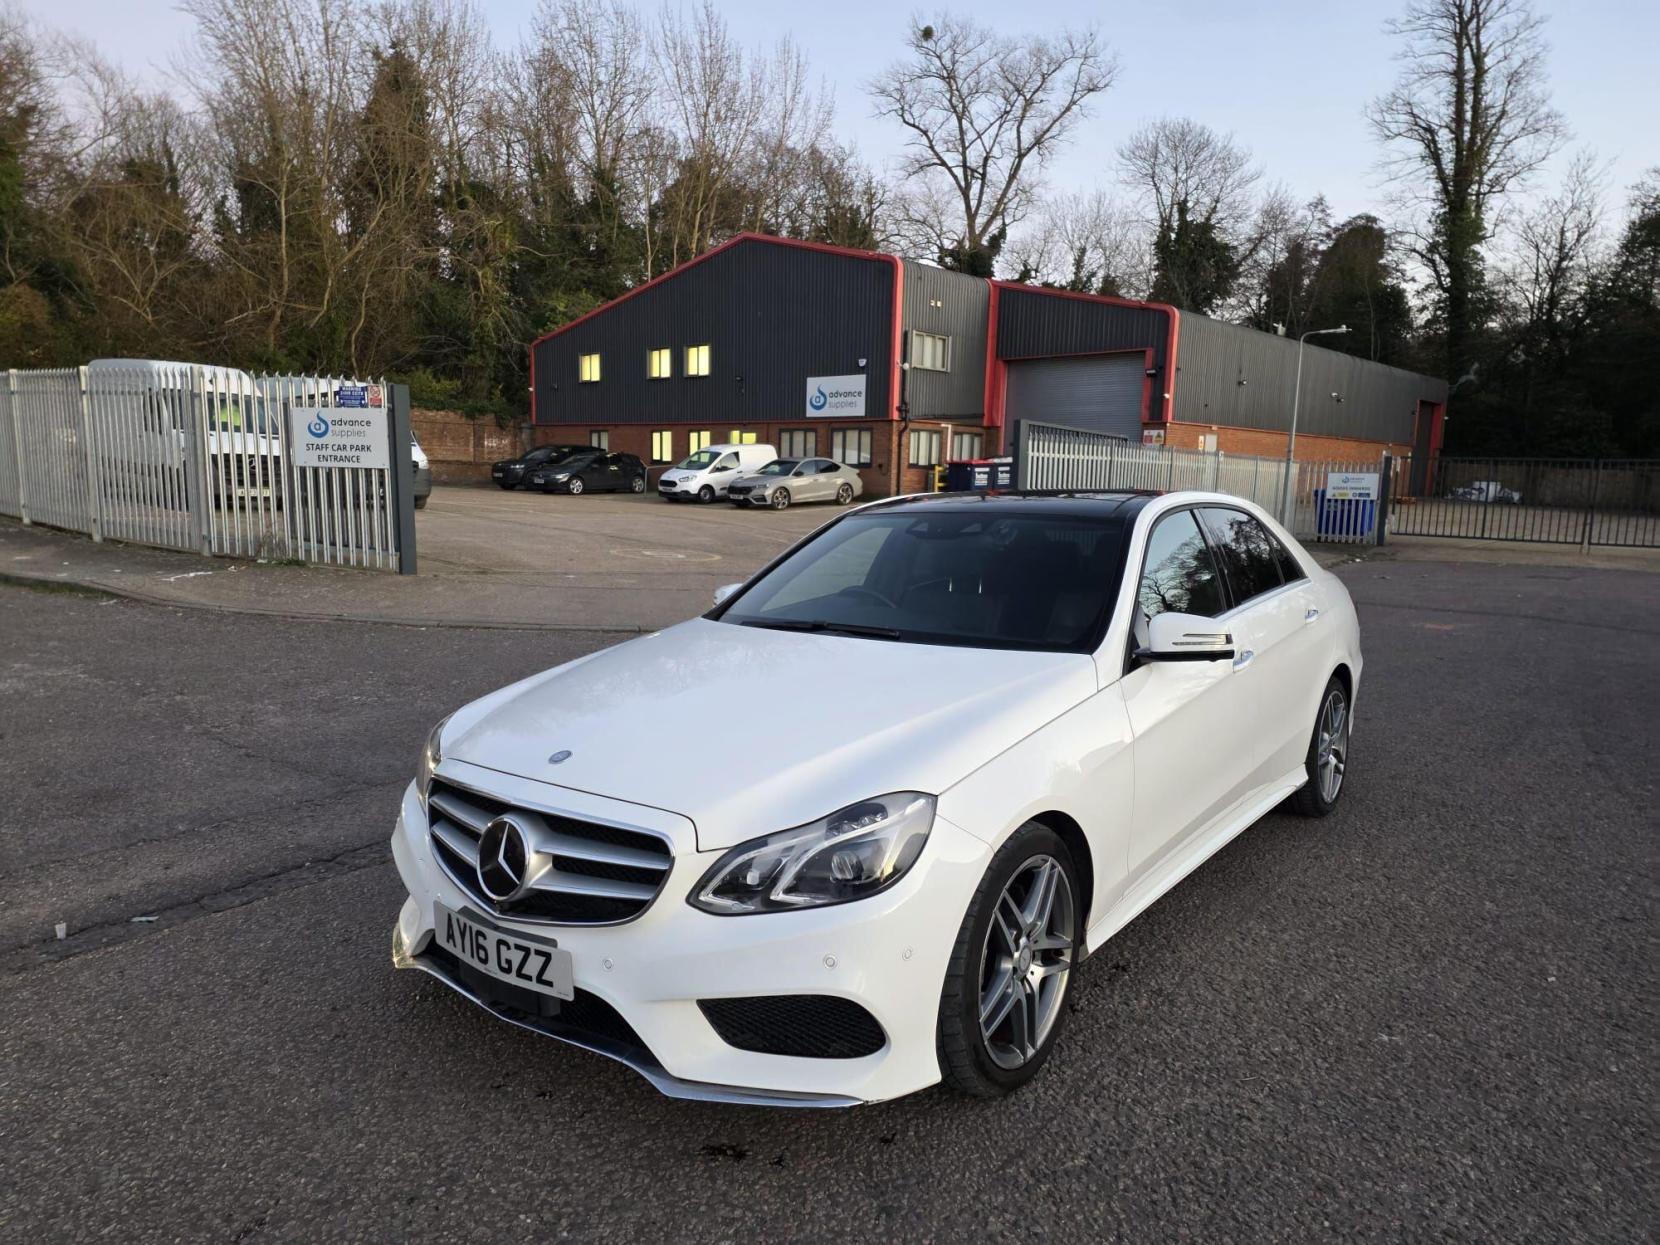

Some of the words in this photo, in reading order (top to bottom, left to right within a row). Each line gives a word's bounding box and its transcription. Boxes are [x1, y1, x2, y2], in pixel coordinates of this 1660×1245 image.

[828, 390, 863, 398] advance
[828, 400, 856, 409] supplies
[330, 418, 371, 427] advance
[331, 429, 366, 438] supplies
[305, 443, 330, 452] STAFF
[331, 443, 348, 452] CAR
[349, 444, 371, 452] PARK
[317, 455, 361, 463] ENTRANCE
[446, 912, 489, 965] AY16
[496, 938, 554, 988] GZZ
